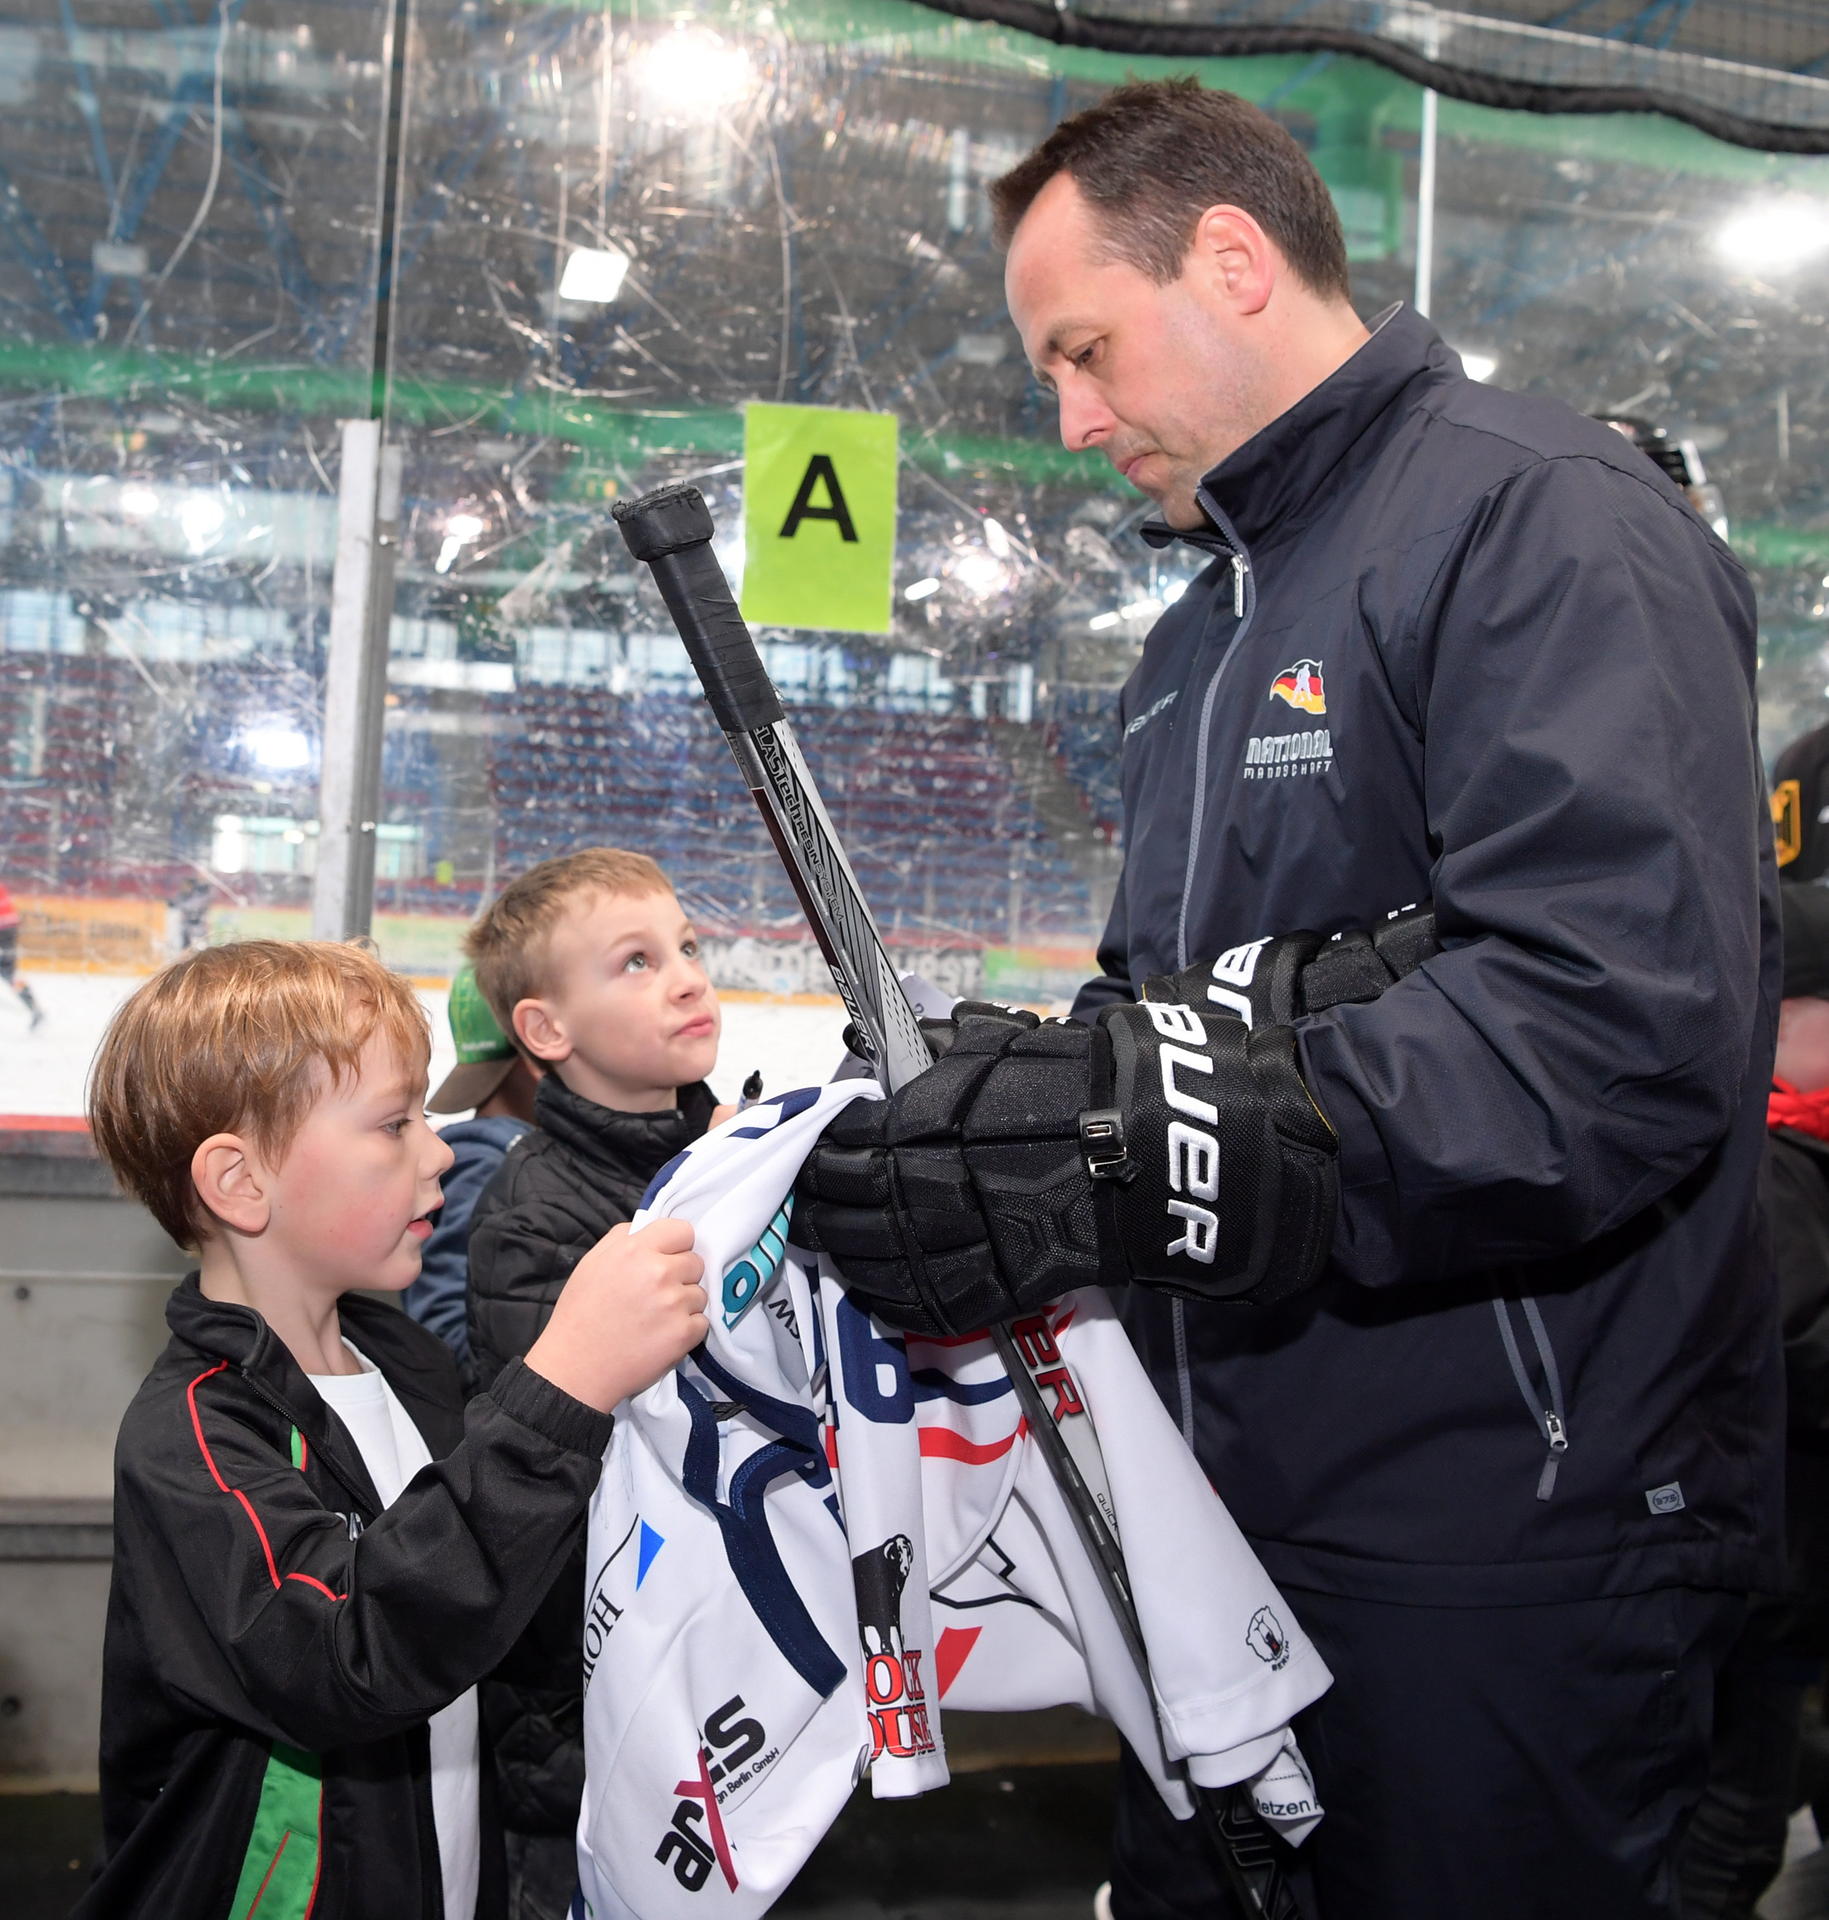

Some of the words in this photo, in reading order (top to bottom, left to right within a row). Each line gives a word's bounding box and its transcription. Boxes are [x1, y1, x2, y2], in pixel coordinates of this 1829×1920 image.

[778, 455, 859, 543] A
[1243, 761, 1332, 779] MANNSCHAFT
[1246, 729, 1333, 765] NATIONAL
[830, 964, 875, 1051] BAUER
[728, 1771, 753, 1793] Berlin
[752, 1747, 780, 1774] GmbH
